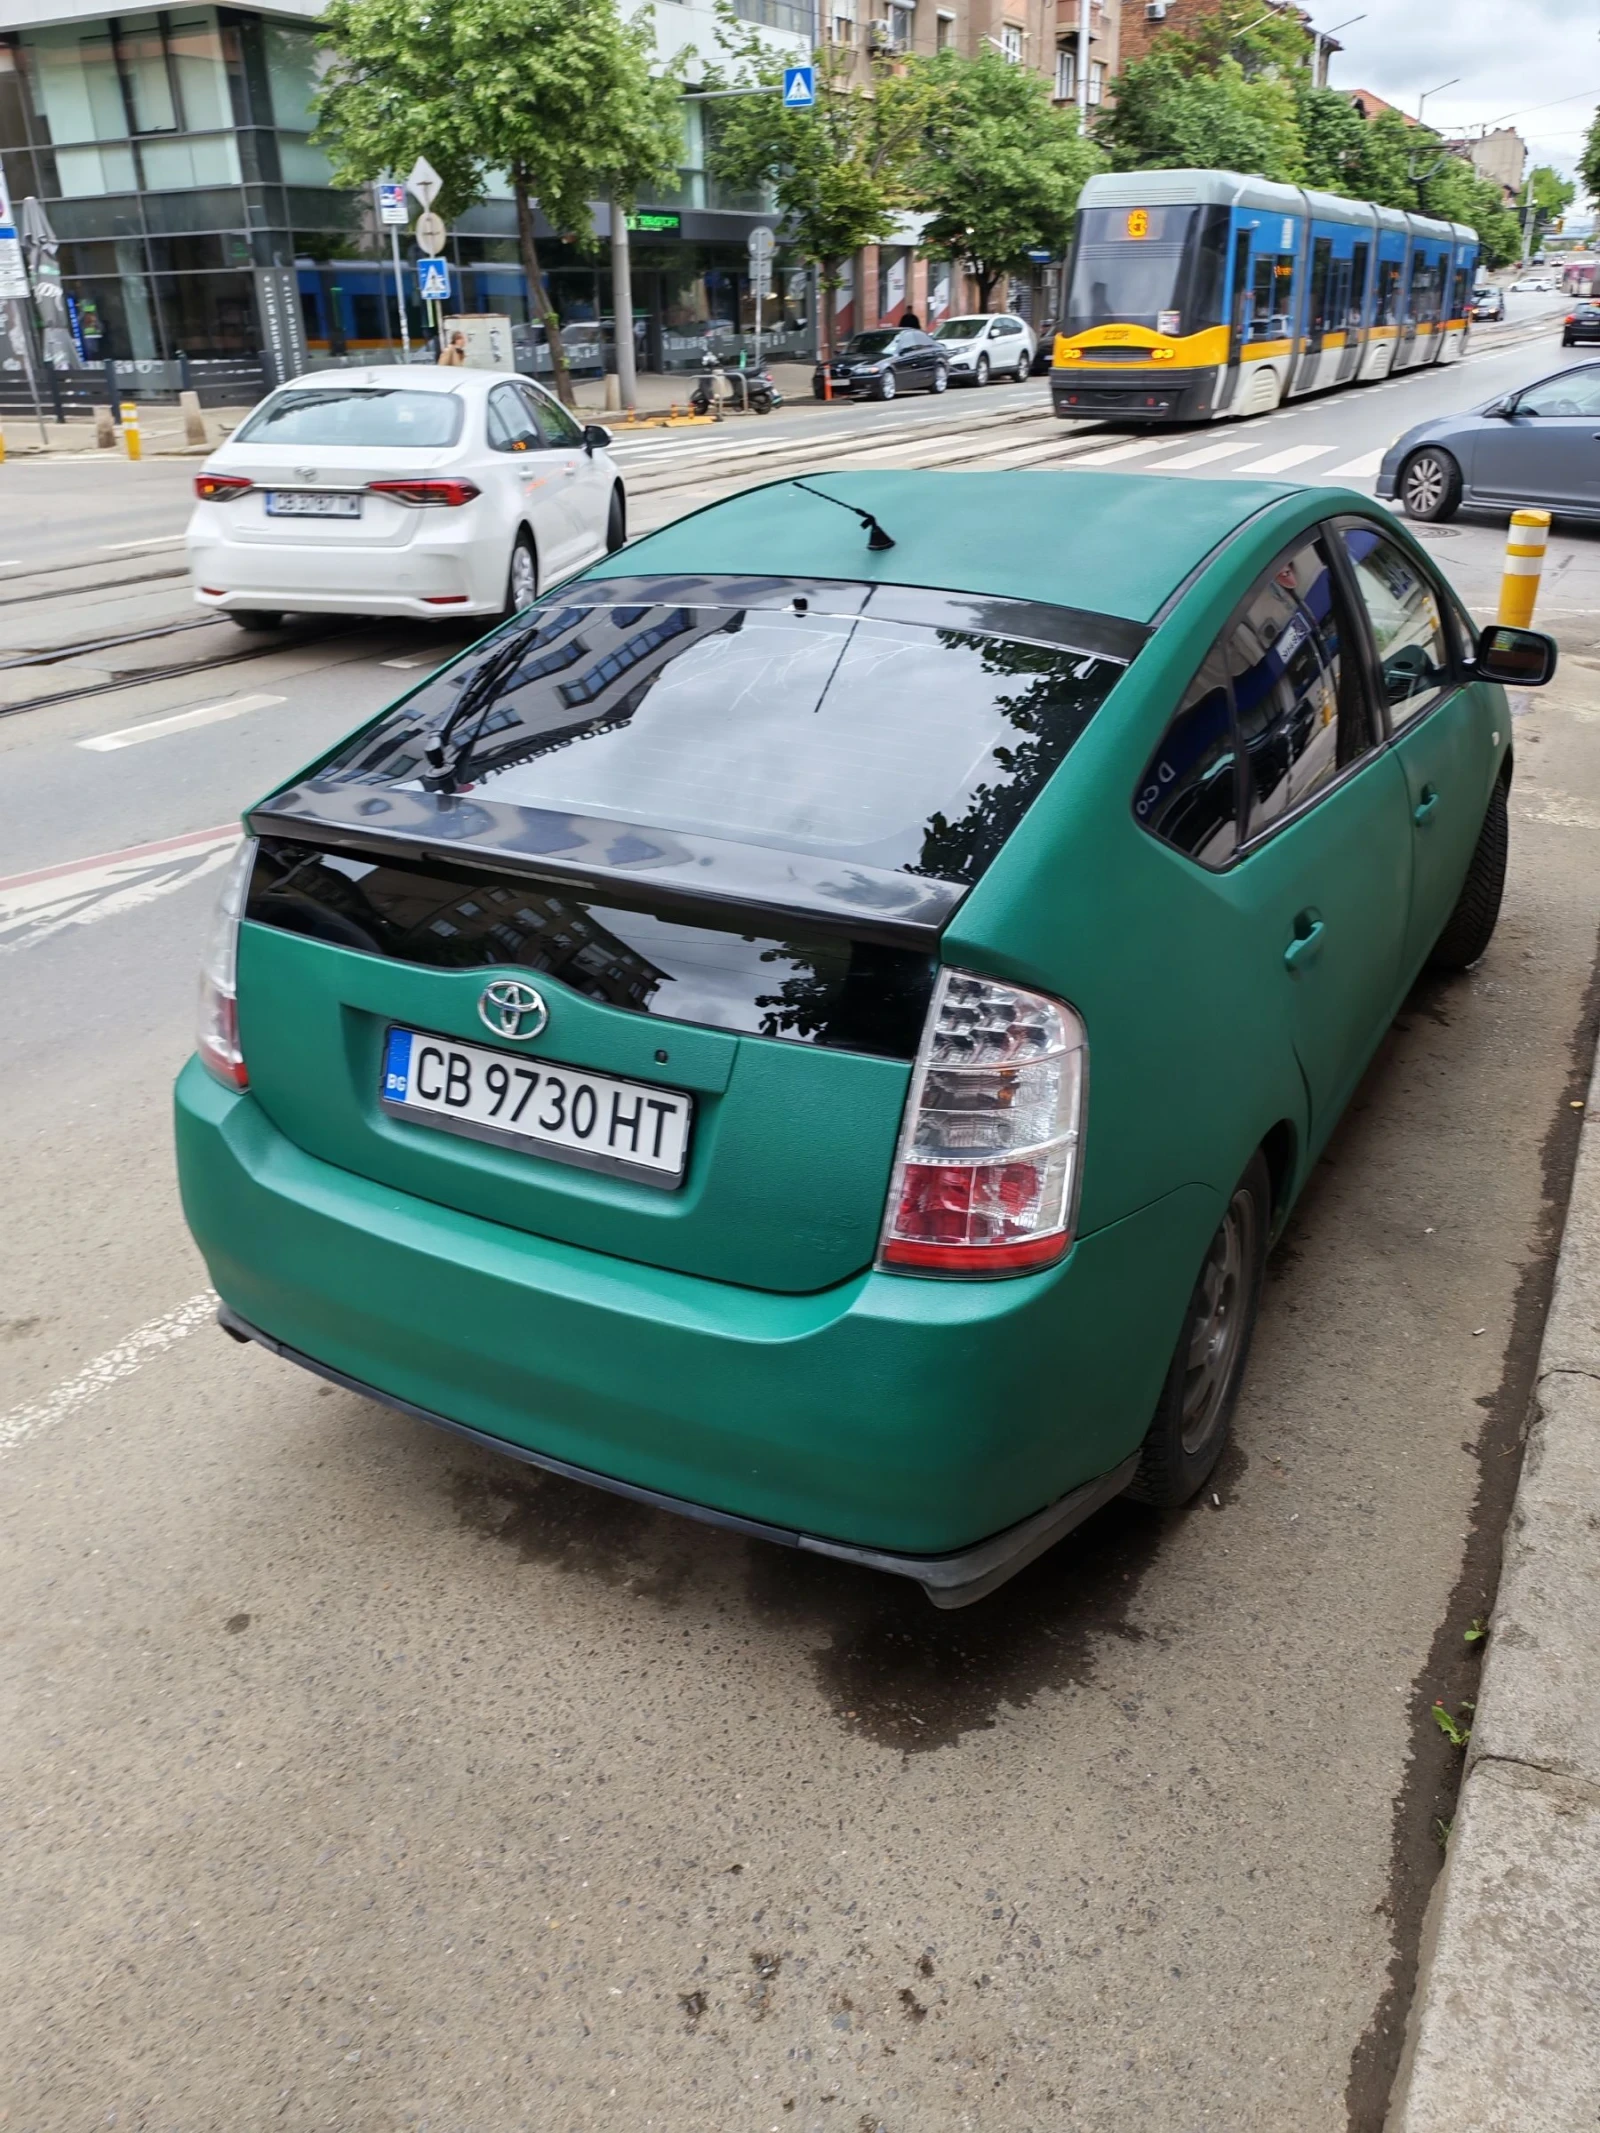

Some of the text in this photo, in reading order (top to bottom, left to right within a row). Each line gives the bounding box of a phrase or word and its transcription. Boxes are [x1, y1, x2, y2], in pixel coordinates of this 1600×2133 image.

[1128, 208, 1148, 237] 6
[387, 1073, 407, 1092] BG
[417, 1047, 678, 1158] CB 9730 HT
